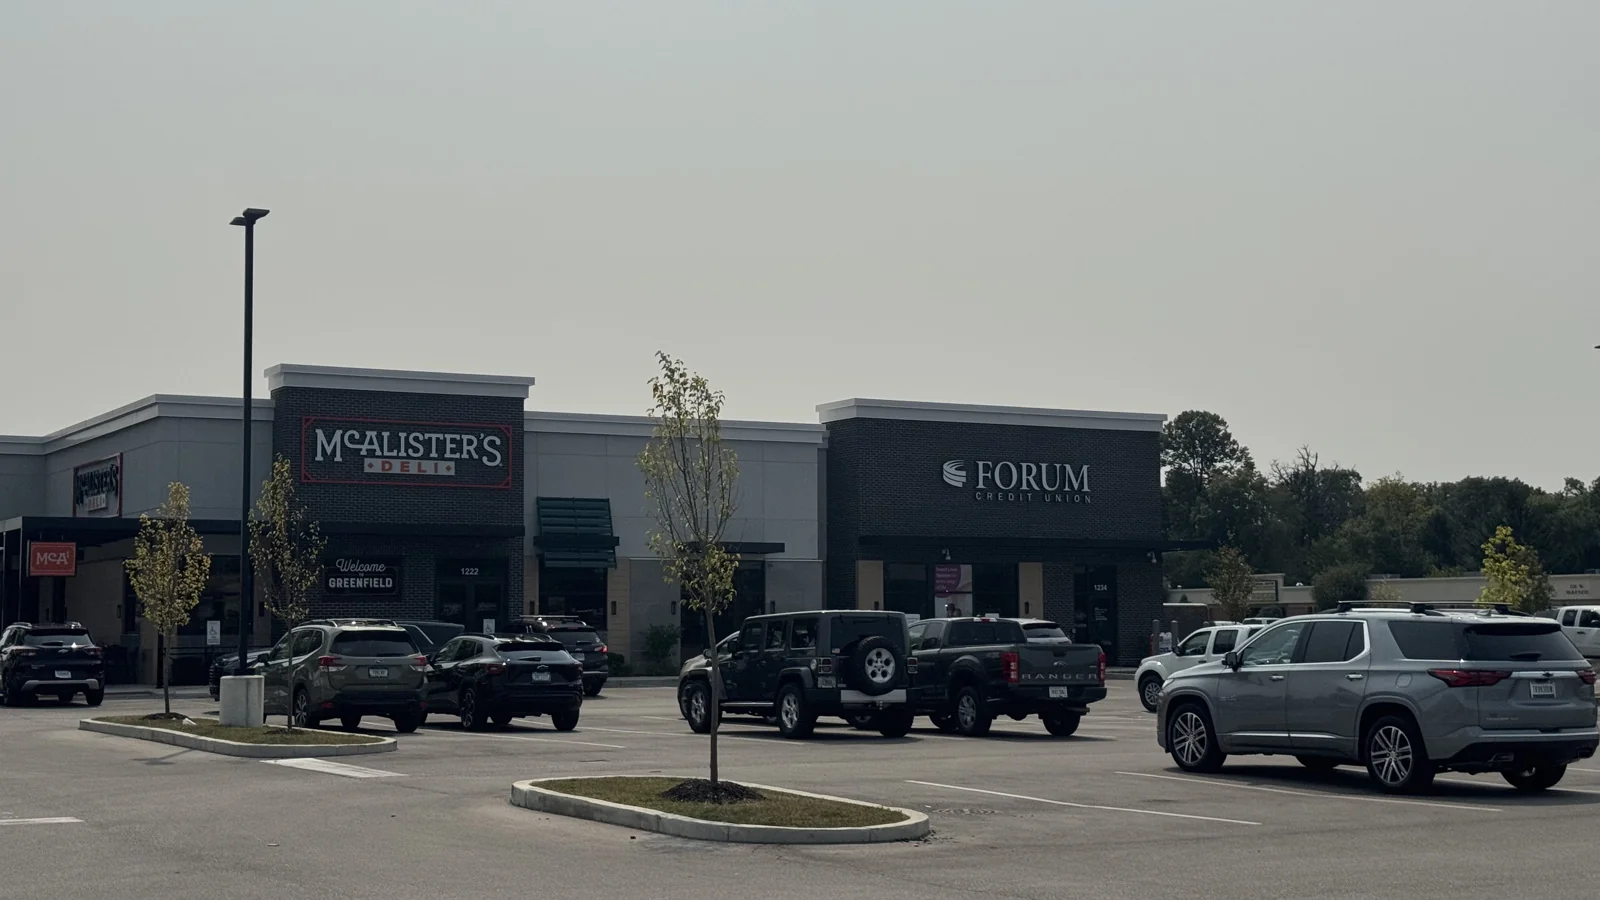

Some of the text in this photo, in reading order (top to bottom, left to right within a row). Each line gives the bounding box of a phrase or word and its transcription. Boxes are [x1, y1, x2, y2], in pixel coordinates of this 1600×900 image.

[381, 460, 439, 474] DELI
[975, 460, 1092, 492] FORUM
[975, 491, 1092, 504] CREDIT UNION
[335, 558, 387, 572] Welcome
[460, 567, 480, 576] 1222
[328, 577, 393, 588] GREENFIELD
